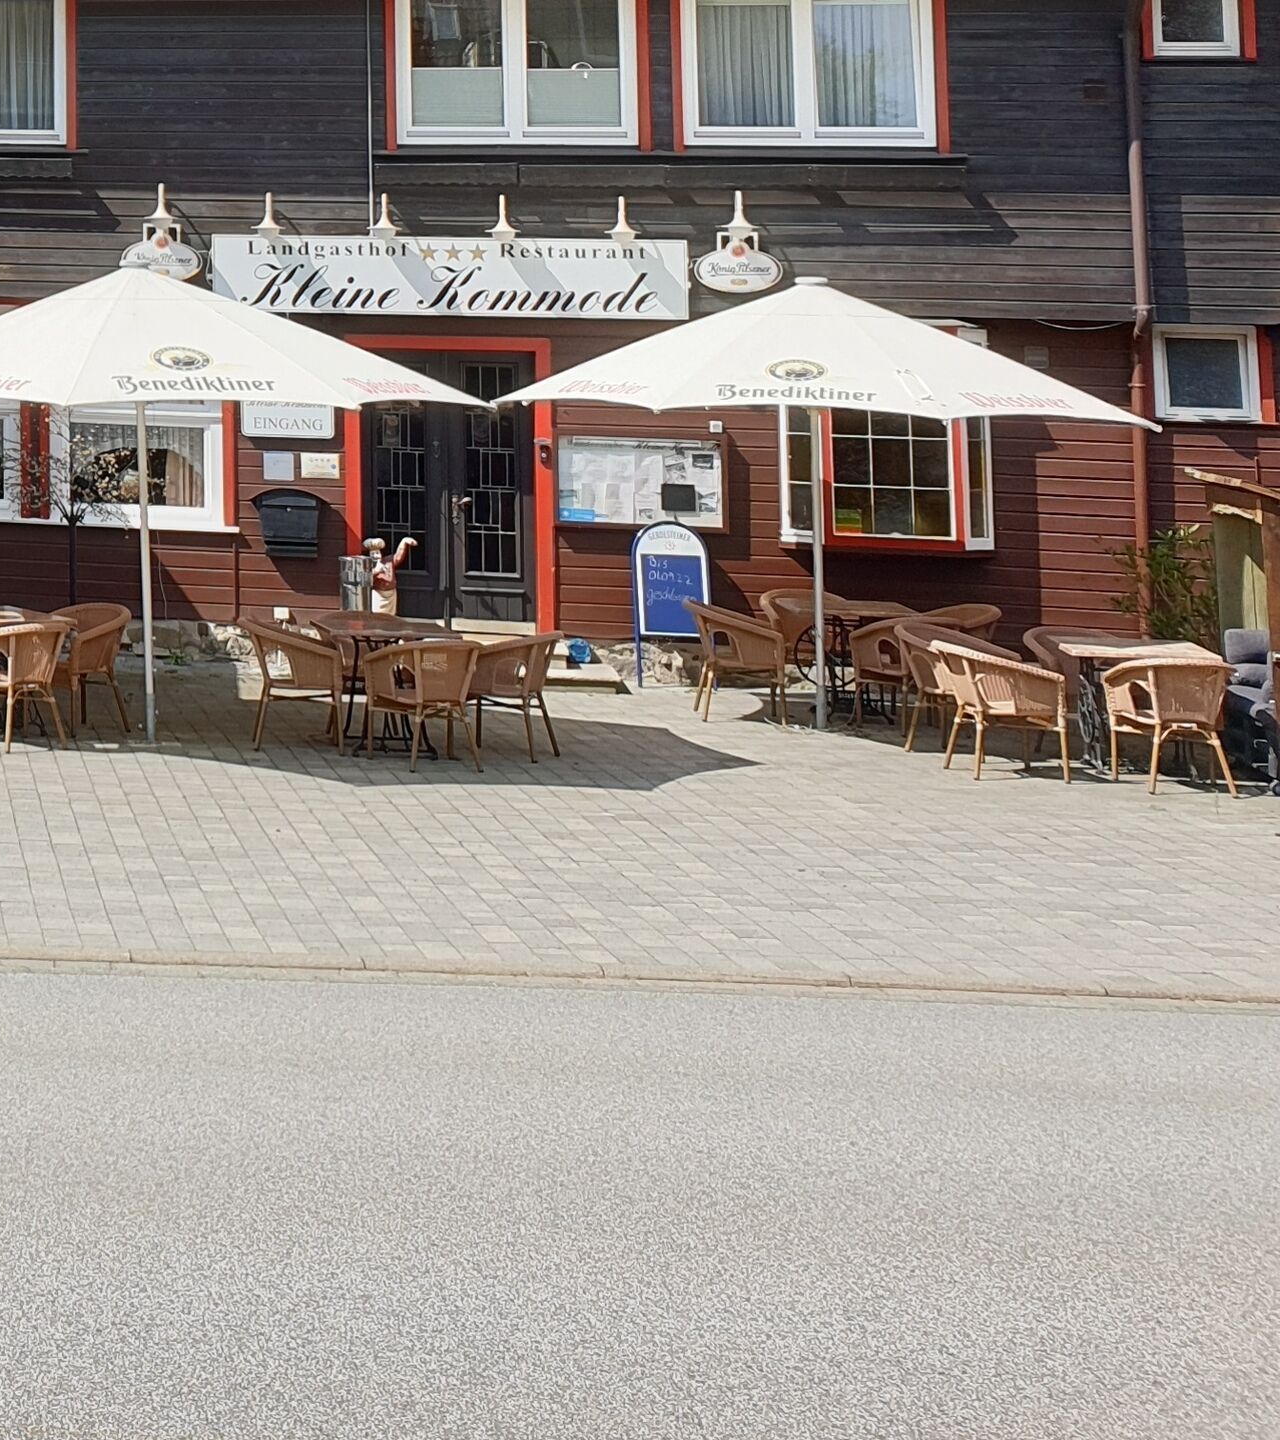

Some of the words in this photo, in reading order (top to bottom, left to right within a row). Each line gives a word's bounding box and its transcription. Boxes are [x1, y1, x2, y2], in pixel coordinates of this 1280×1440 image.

[248, 240, 410, 260] Landgasthof
[499, 243, 647, 260] Restaurant
[241, 263, 400, 309] Kleine
[416, 265, 659, 313] Kommode
[113, 375, 275, 394] Benediktiner
[558, 380, 647, 395] Weissbier
[716, 383, 877, 402] Benediktiner
[959, 391, 1073, 409] Weissbier
[253, 416, 323, 431] EINGANG
